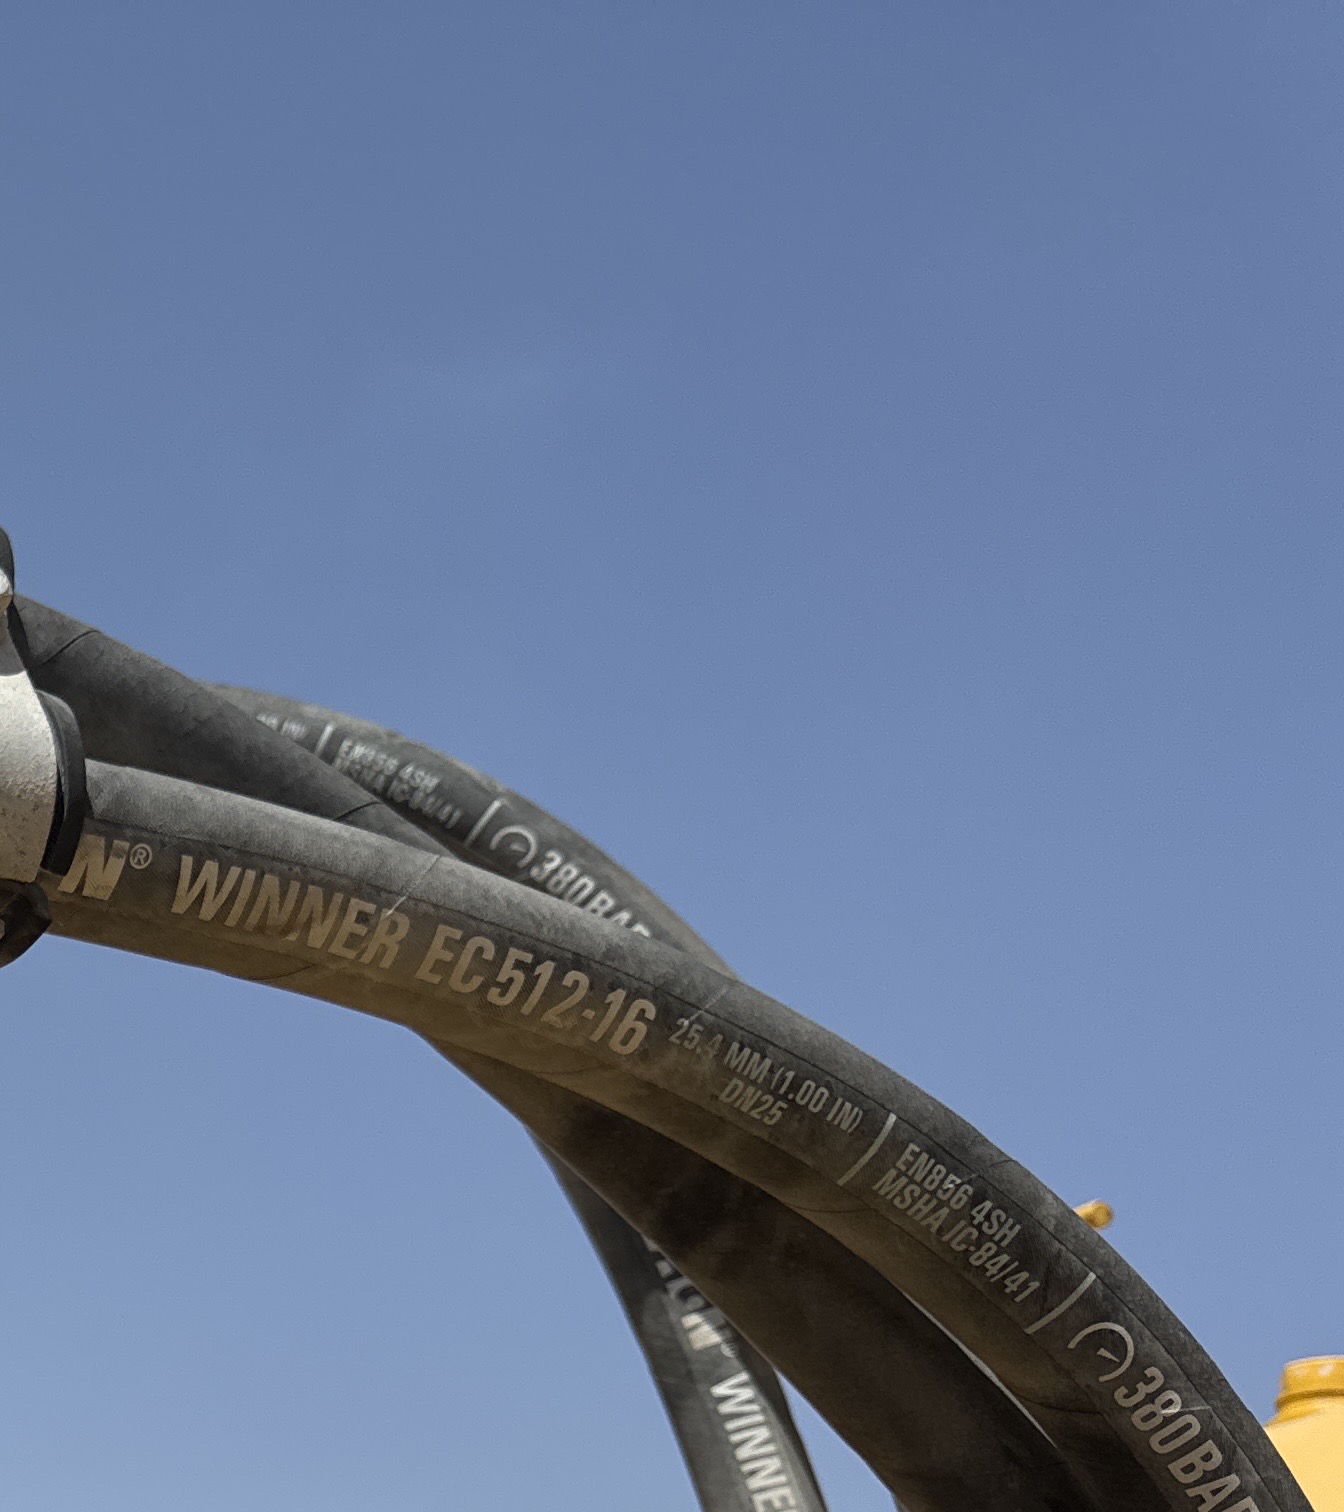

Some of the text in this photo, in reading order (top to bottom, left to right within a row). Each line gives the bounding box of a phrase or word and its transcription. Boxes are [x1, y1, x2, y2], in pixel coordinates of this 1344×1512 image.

[171, 855, 410, 969] WINNER
[416, 926, 656, 1056] EC512-16
[669, 1017, 863, 1135] 25.4 MM (1.00 IN)
[719, 1078, 789, 1126] DN25
[872, 1170, 1041, 1303] MSHA IC-84/41
[895, 1142, 1021, 1247] EN856 4SH
